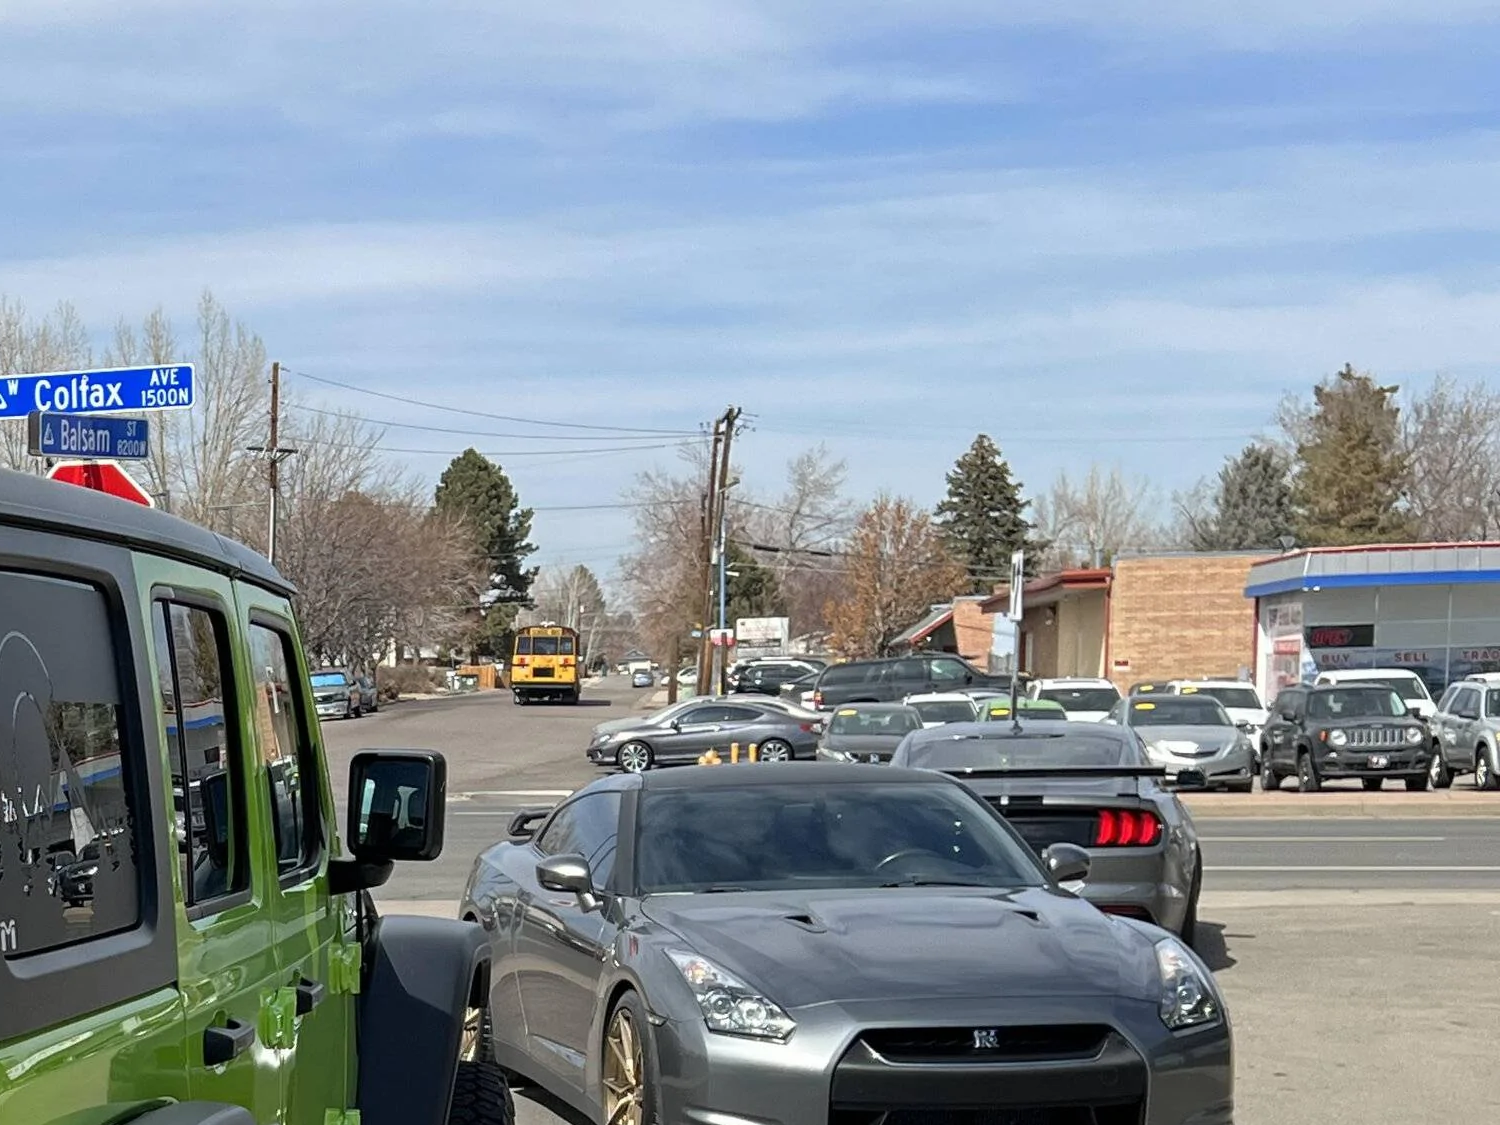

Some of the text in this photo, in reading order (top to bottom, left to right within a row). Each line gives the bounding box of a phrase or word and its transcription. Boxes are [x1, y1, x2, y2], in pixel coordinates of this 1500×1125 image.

[149, 368, 179, 386] AVE
[7, 374, 124, 411] W Colfax
[141, 387, 189, 407] 1500N
[60, 418, 111, 453] Balsam
[126, 422, 137, 437] ST
[1322, 654, 1350, 664] BUY
[1395, 652, 1430, 662] SELL
